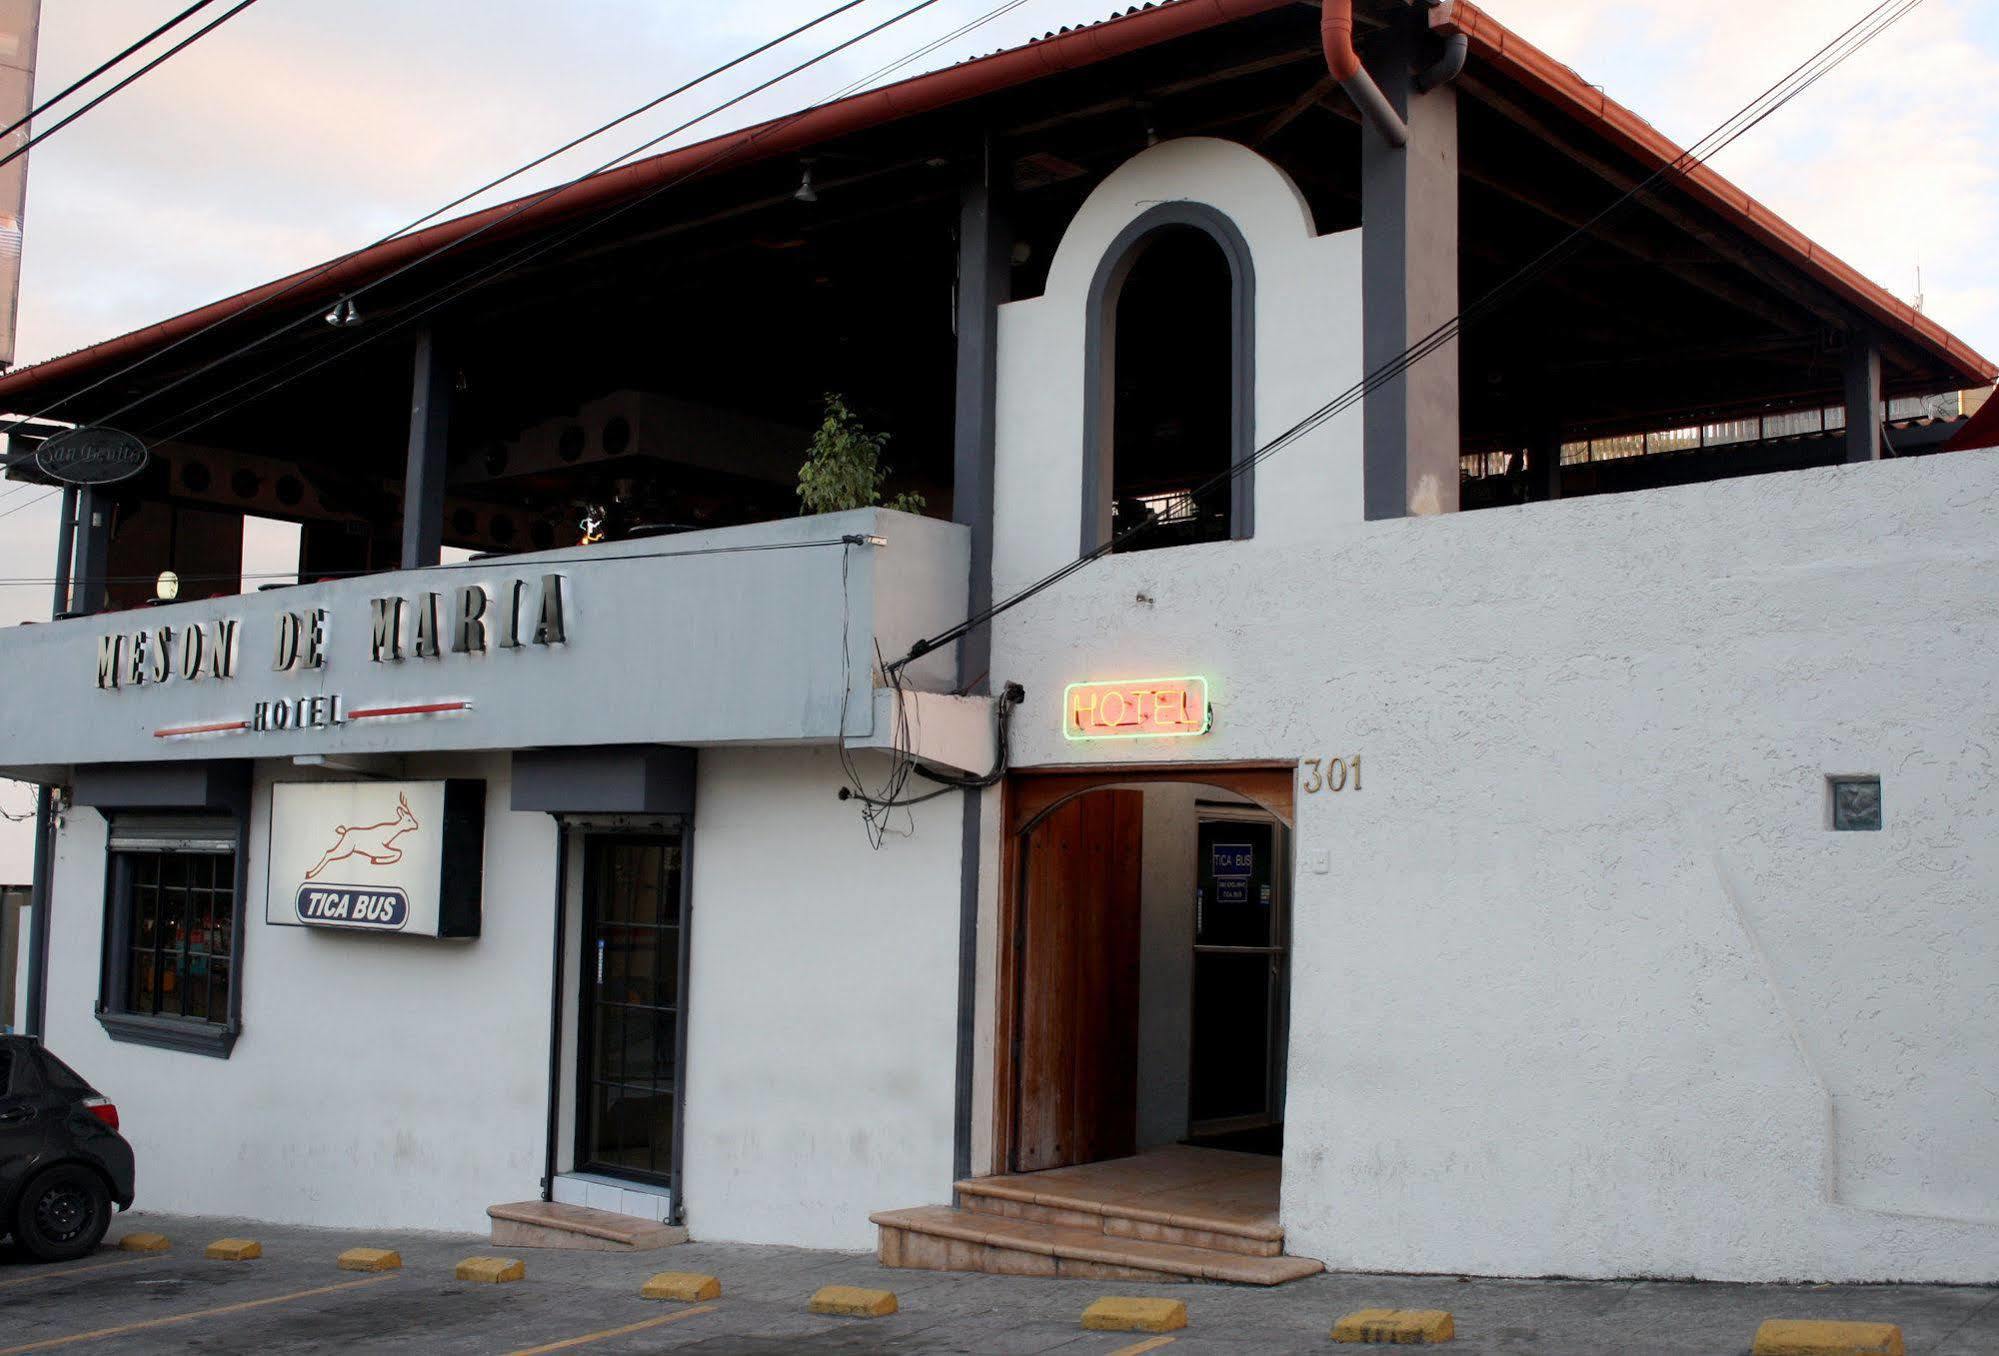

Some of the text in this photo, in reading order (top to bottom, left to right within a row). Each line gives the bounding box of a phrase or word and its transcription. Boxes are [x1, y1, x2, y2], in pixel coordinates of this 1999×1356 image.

[97, 574, 567, 688] MESON DE MARIA
[254, 694, 344, 731] HOTEL
[1073, 689, 1198, 728] HOTEL
[1303, 754, 1362, 794] 301
[1214, 854, 1252, 867] TICA BUS
[307, 892, 397, 921] TICA BUS
